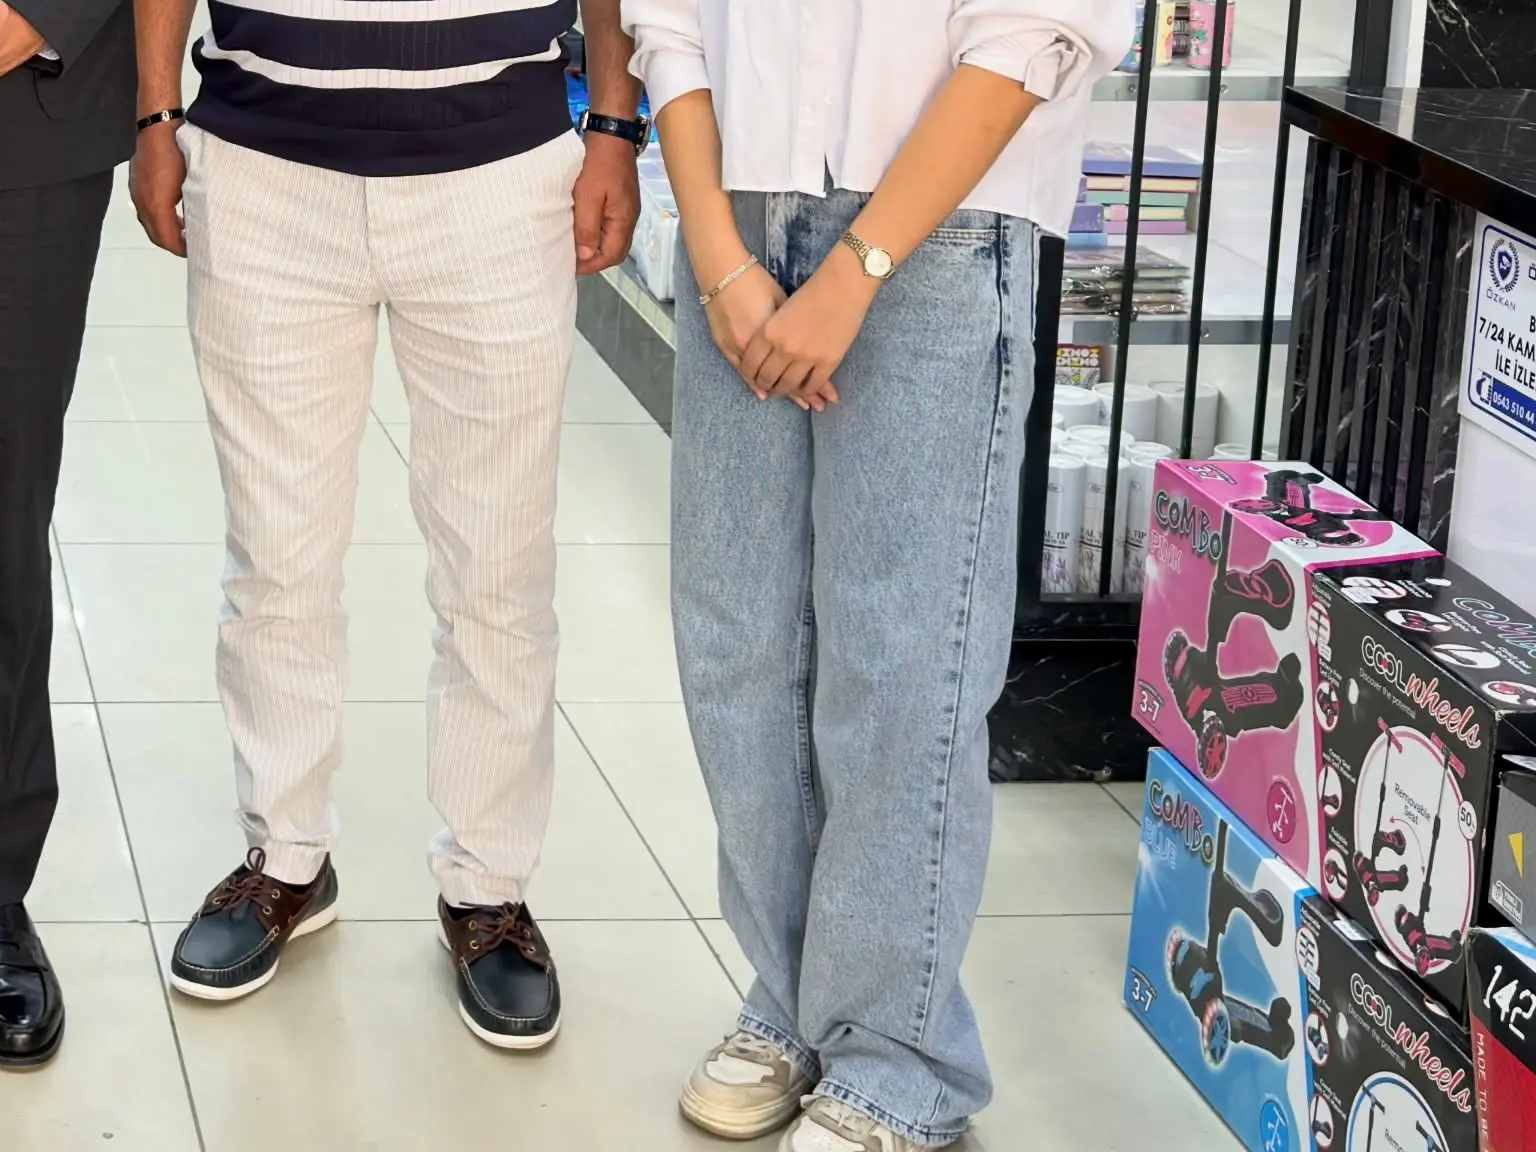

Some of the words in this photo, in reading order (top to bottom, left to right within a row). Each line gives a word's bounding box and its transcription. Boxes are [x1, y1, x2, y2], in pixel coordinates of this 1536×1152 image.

[1486, 286, 1516, 311] ÖZKAN
[1479, 316, 1504, 345] 7/24
[1495, 348, 1511, 376] İLE
[1513, 358, 1536, 391] İZLE
[1492, 391, 1510, 410] 0543
[1511, 401, 1524, 418] 510
[1359, 667, 1383, 693] Discover
[1382, 685, 1392, 700] the
[1391, 692, 1416, 720] potential
[1394, 782, 1431, 823] Removable
[1403, 805, 1419, 826] Seat
[1348, 1003, 1372, 1031] Discover
[1371, 1025, 1382, 1043] the
[1381, 1039, 1406, 1070] potential
[1476, 1032, 1488, 1081] MADE
